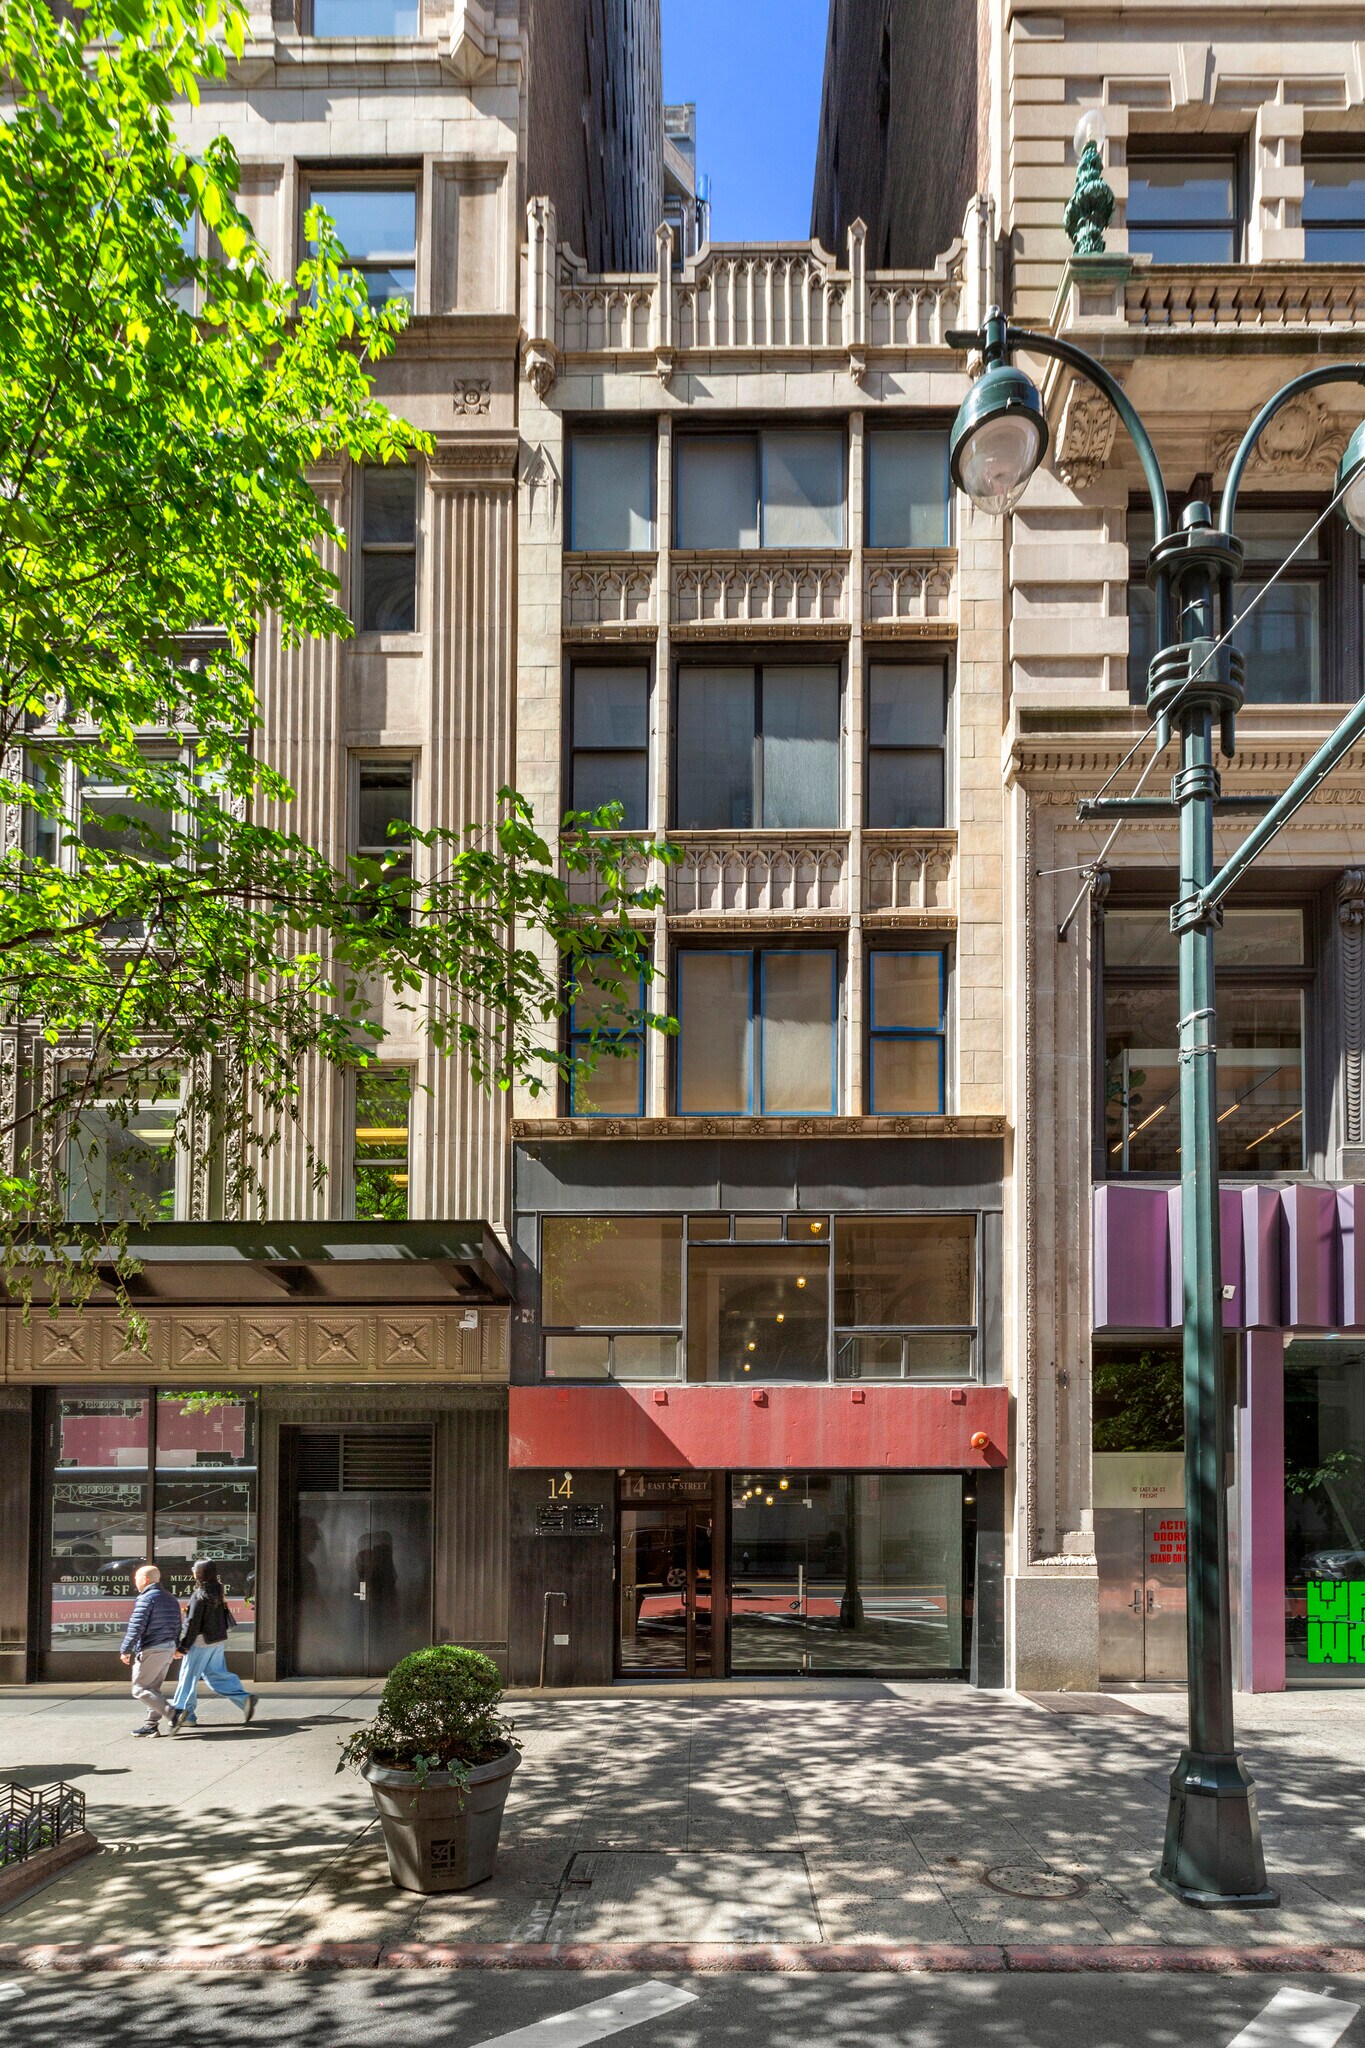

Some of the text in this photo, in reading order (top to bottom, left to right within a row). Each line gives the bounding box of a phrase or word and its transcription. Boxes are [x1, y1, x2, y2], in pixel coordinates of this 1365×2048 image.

[548, 1478, 574, 1499] 14
[621, 1475, 646, 1498] 14
[648, 1482, 665, 1490] EAST
[679, 1482, 707, 1490] STREET
[1160, 1544, 1173, 1552] DO
[1150, 1554, 1171, 1564] STAND
[1173, 1554, 1182, 1563] OR
[61, 1585, 130, 1597] 10,397 SF
[60, 1623, 121, 1635] ,581 SF
